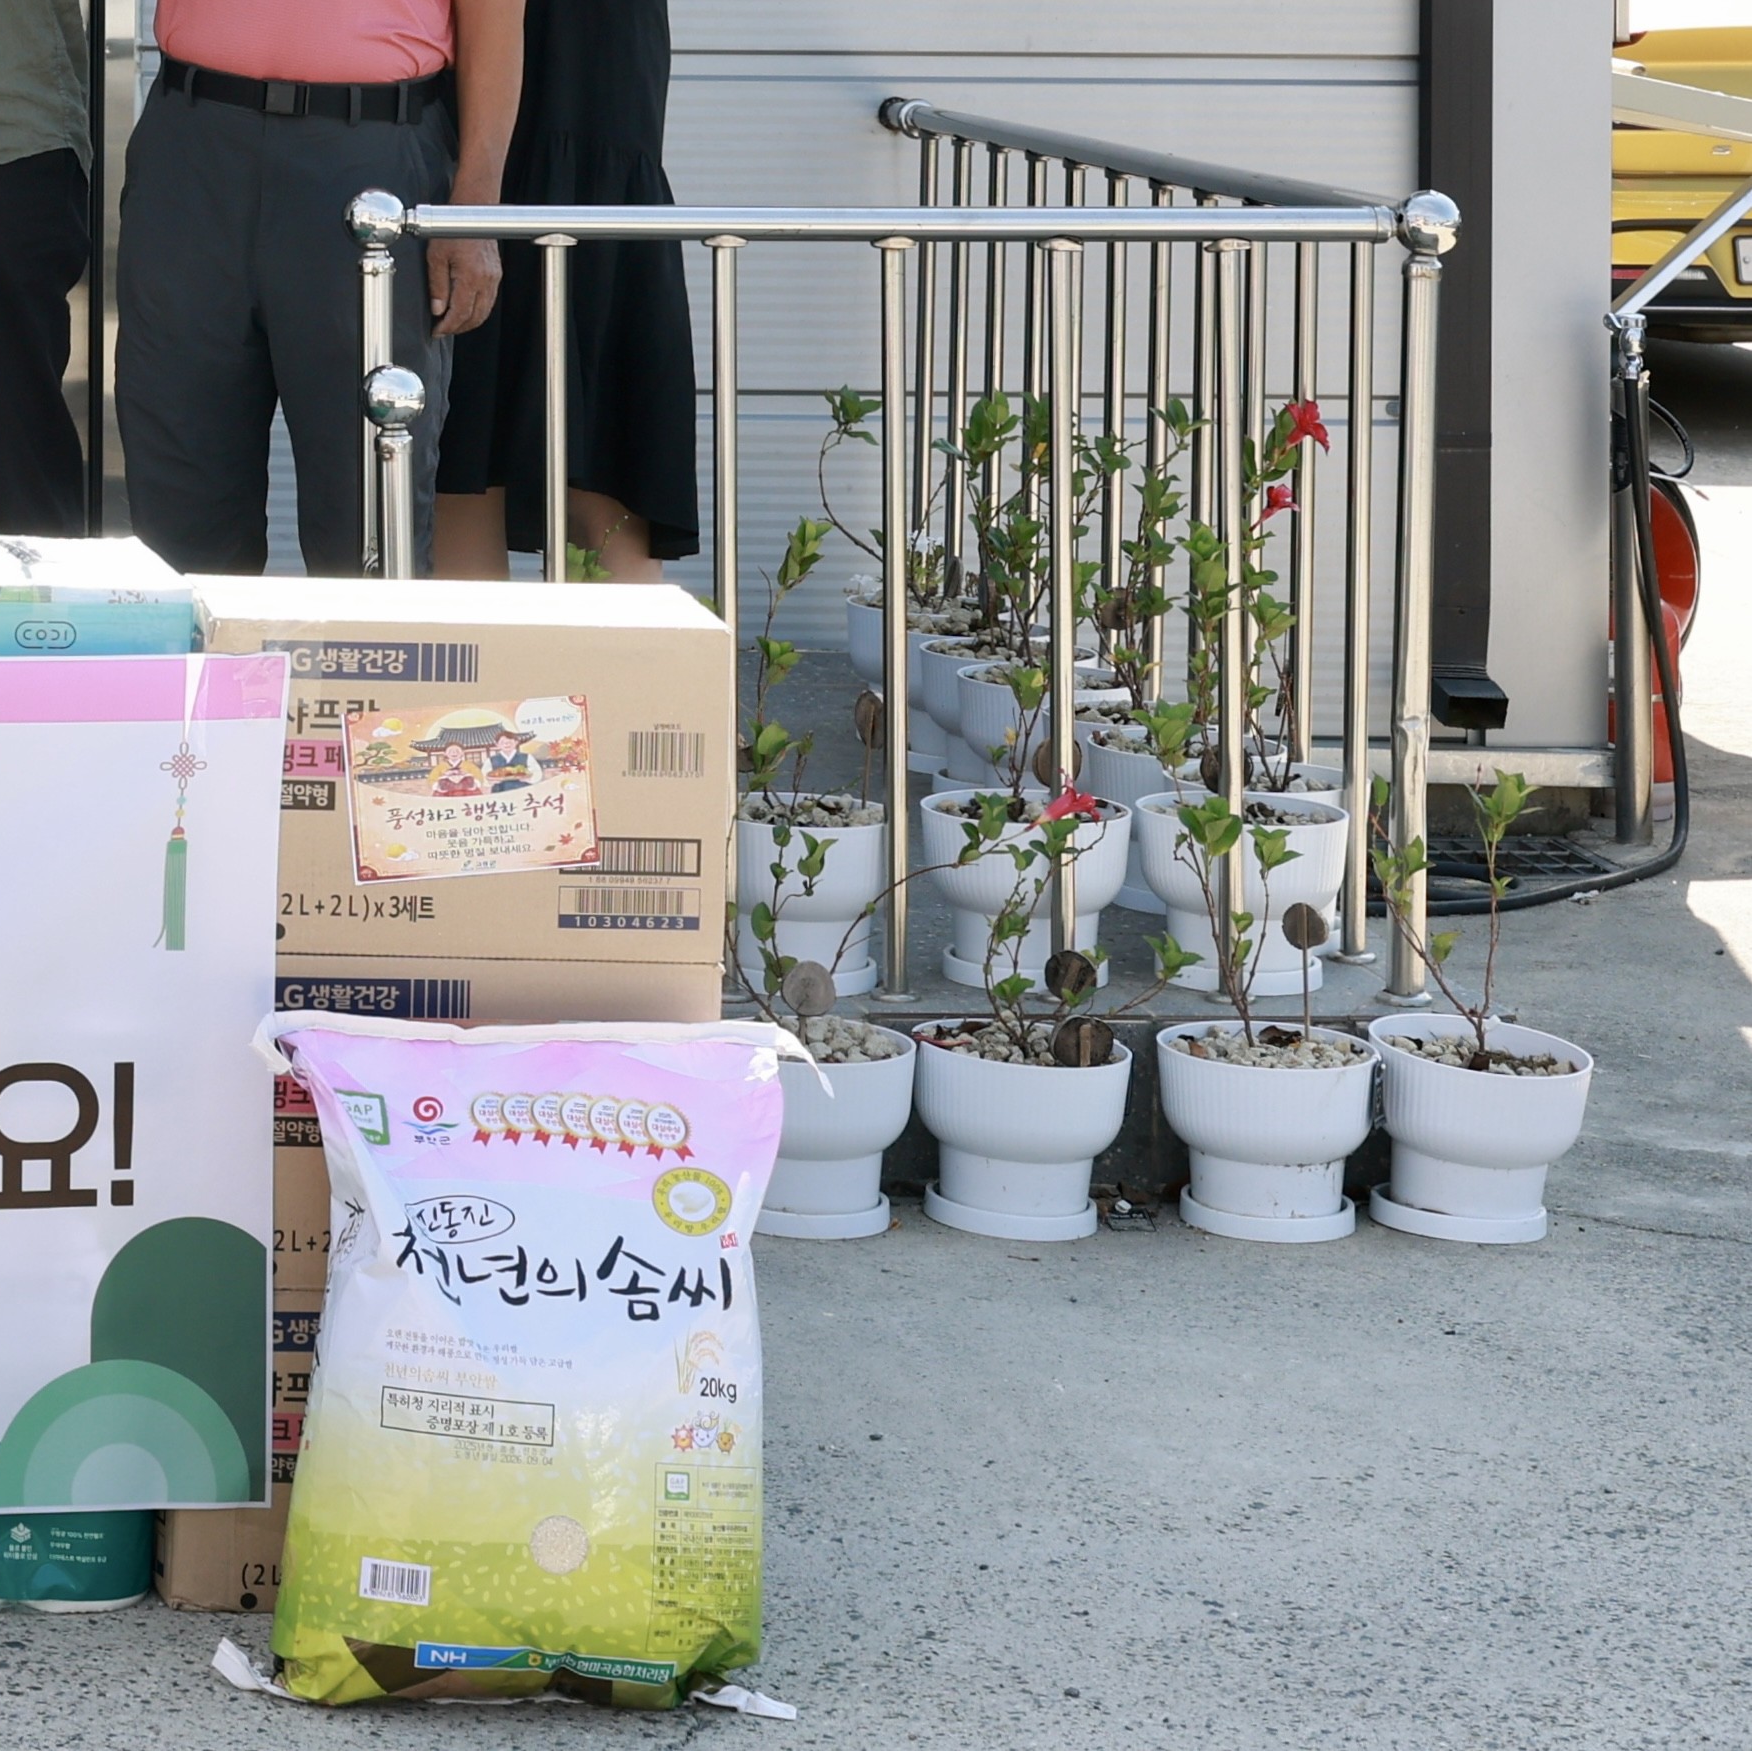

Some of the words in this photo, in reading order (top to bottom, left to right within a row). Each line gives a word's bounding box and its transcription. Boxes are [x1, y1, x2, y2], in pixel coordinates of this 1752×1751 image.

[315, 647, 408, 674] 생활건강
[386, 806, 458, 831] 풍성하고
[461, 801, 518, 822] 행복한
[522, 792, 566, 818] 추석
[308, 983, 401, 1011] 생활건강
[417, 1201, 496, 1239] 신동진
[699, 1376, 738, 1404] 20kg
[387, 1393, 425, 1411] 특허청
[428, 1398, 466, 1416] 지리적
[469, 1404, 495, 1420] 표시
[426, 1415, 480, 1436] 증명포장
[482, 1422, 495, 1438] 제
[499, 1424, 520, 1439] 1호
[522, 1426, 549, 1442] 등록
[430, 1650, 468, 1665] NH
